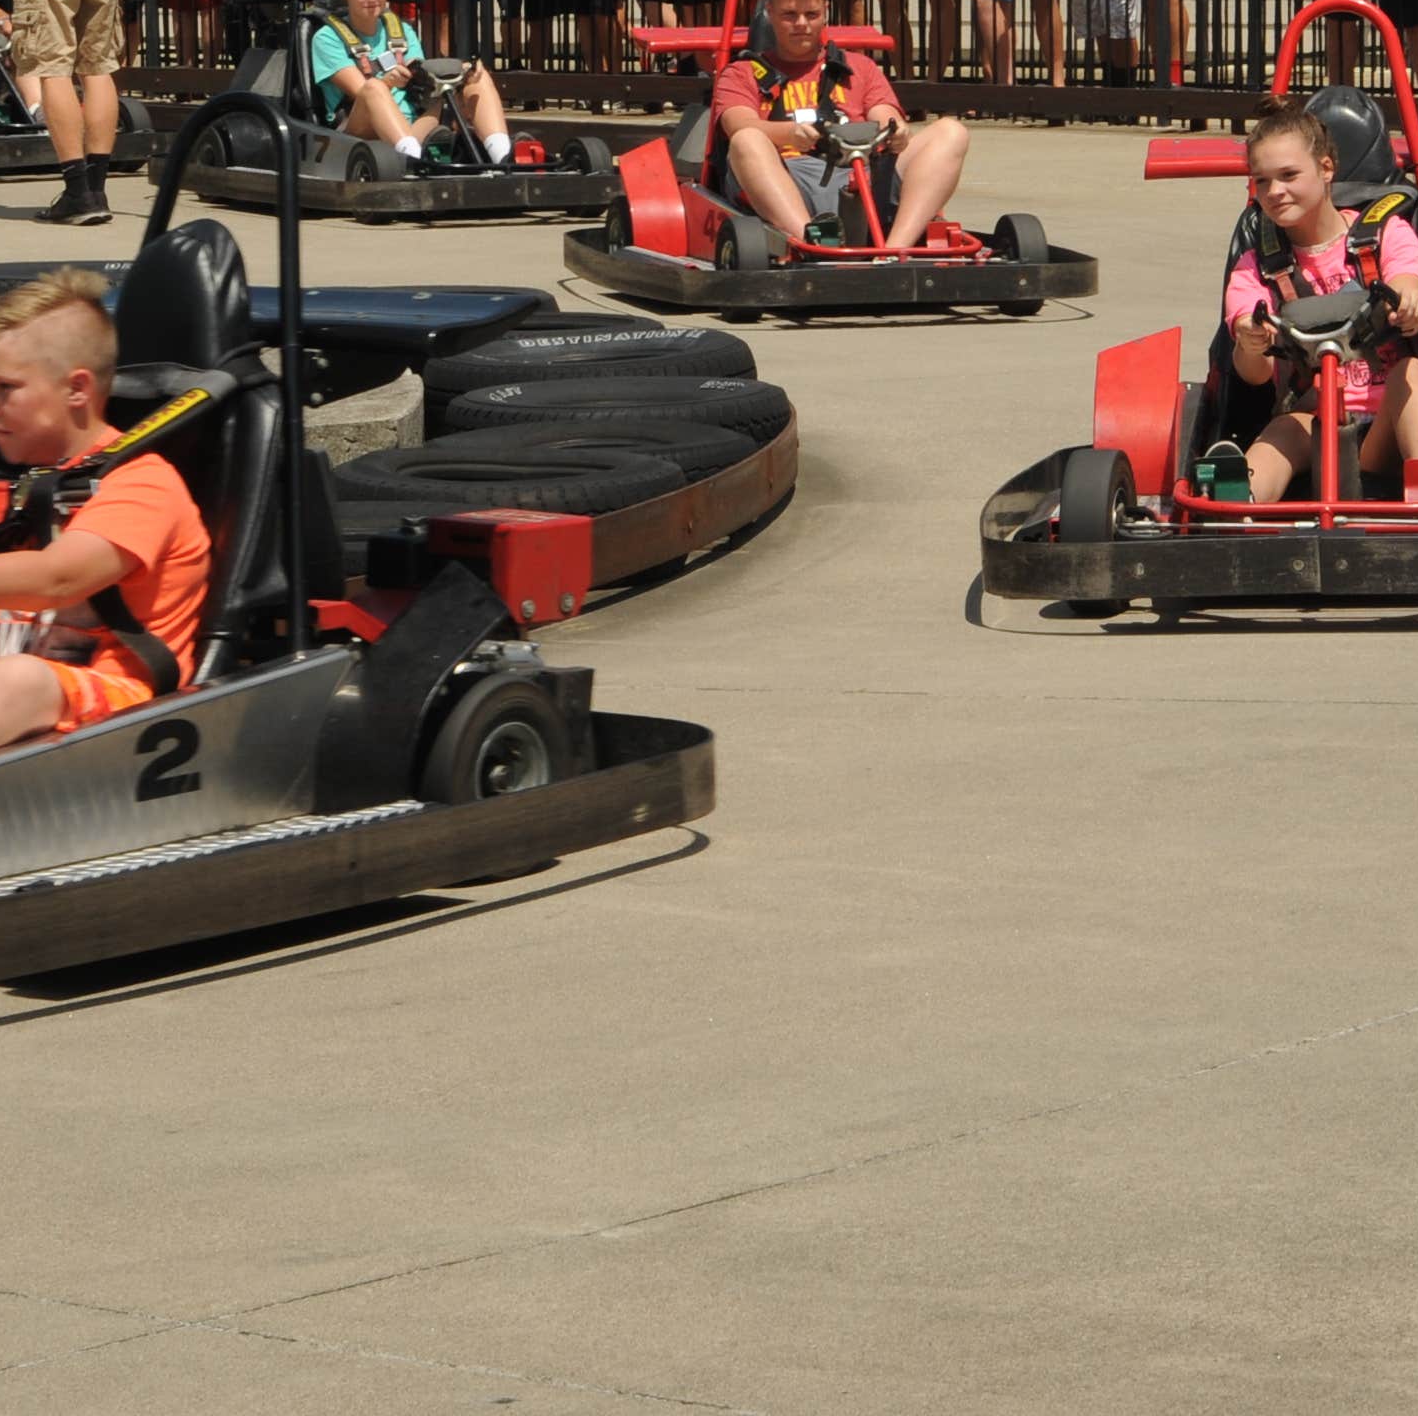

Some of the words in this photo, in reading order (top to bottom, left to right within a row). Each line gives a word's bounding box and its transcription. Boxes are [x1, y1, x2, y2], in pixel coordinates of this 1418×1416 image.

[299, 133, 330, 163] 17
[517, 329, 687, 348] DESTINATION
[135, 719, 203, 803] 2
